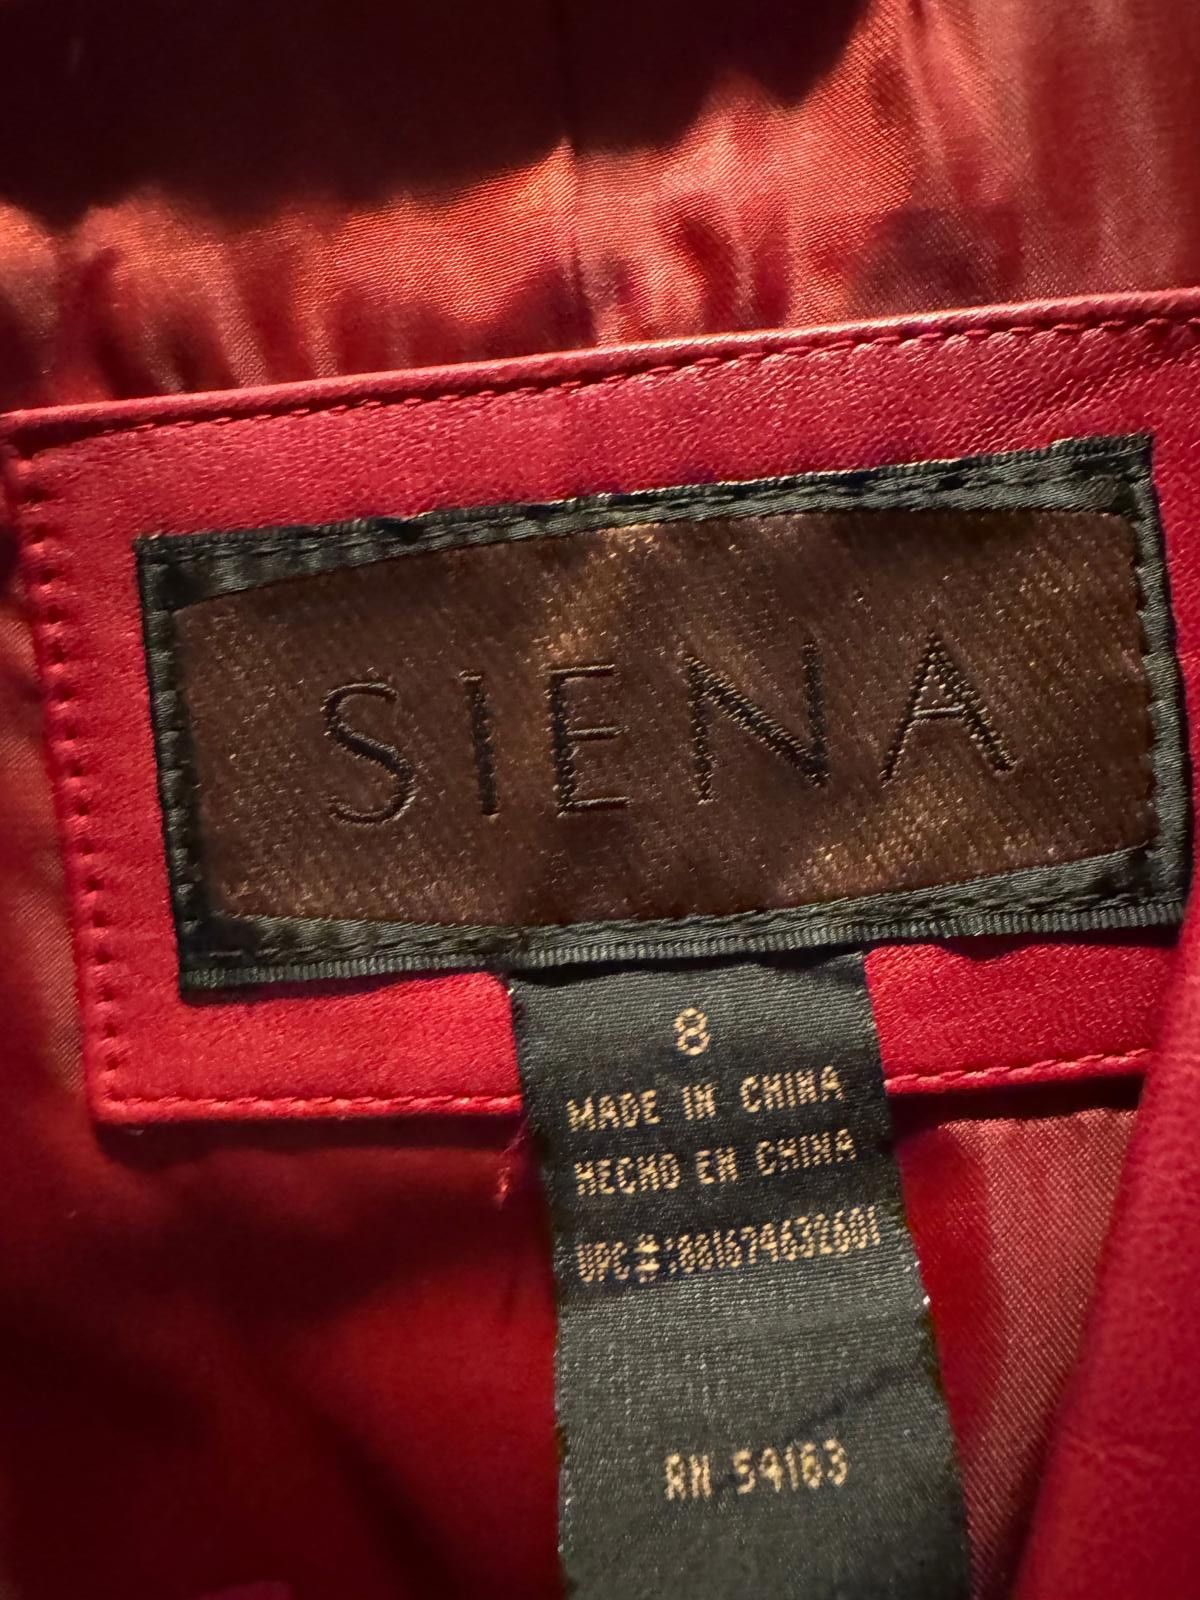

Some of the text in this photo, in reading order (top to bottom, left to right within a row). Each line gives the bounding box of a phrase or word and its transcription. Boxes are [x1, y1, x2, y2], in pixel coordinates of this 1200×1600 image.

[322, 632, 1018, 825] SIENA
[674, 1007, 711, 1056] 8
[566, 1065, 846, 1132] MADE IN CHINA
[574, 1128, 857, 1197] HECHO EN CHINA
[664, 1438, 848, 1500] RN 54163
